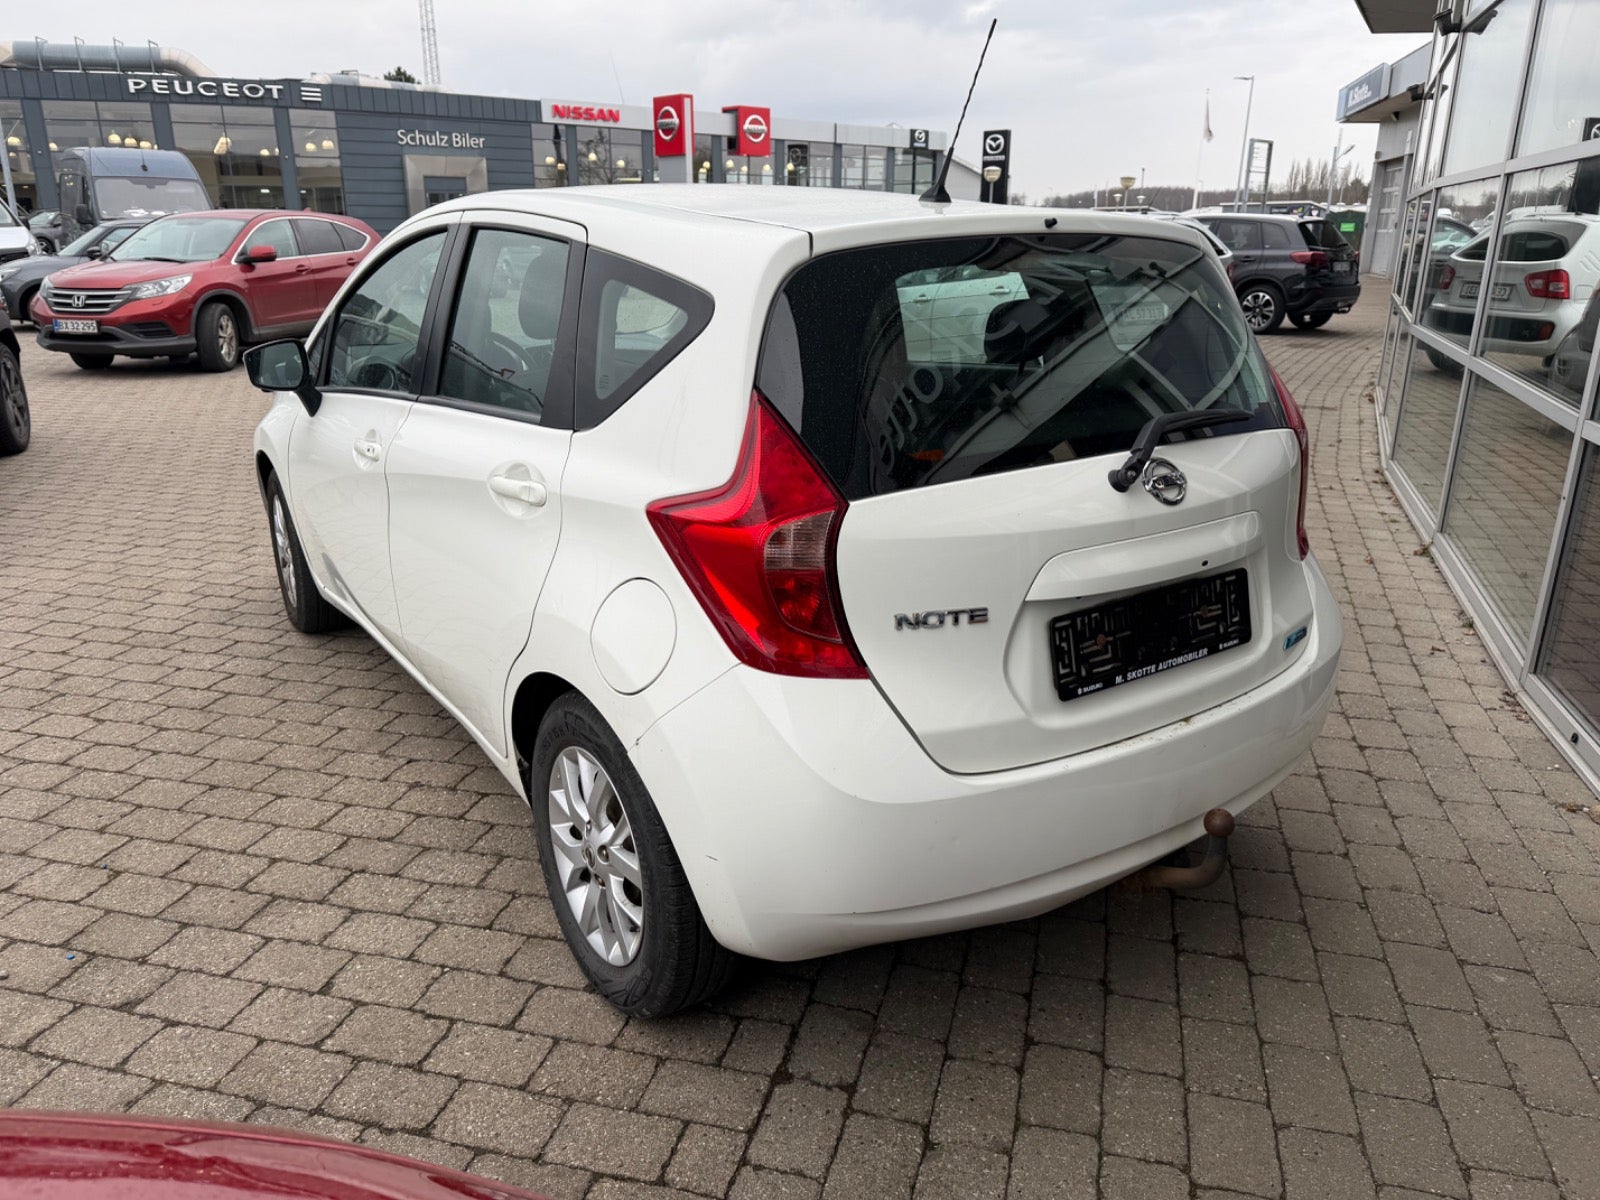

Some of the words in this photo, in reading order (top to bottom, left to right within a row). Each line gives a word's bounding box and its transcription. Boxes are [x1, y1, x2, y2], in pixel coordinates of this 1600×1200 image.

[127, 78, 284, 99] PEUGEOT
[551, 103, 620, 123] NISSAN
[397, 129, 449, 147] Schulz
[452, 132, 486, 149] Biler
[894, 607, 989, 631] NOTE
[1115, 675, 1125, 685] M.
[1126, 663, 1156, 681] SKOTTE
[1158, 647, 1209, 672] AUTOMOBILER
